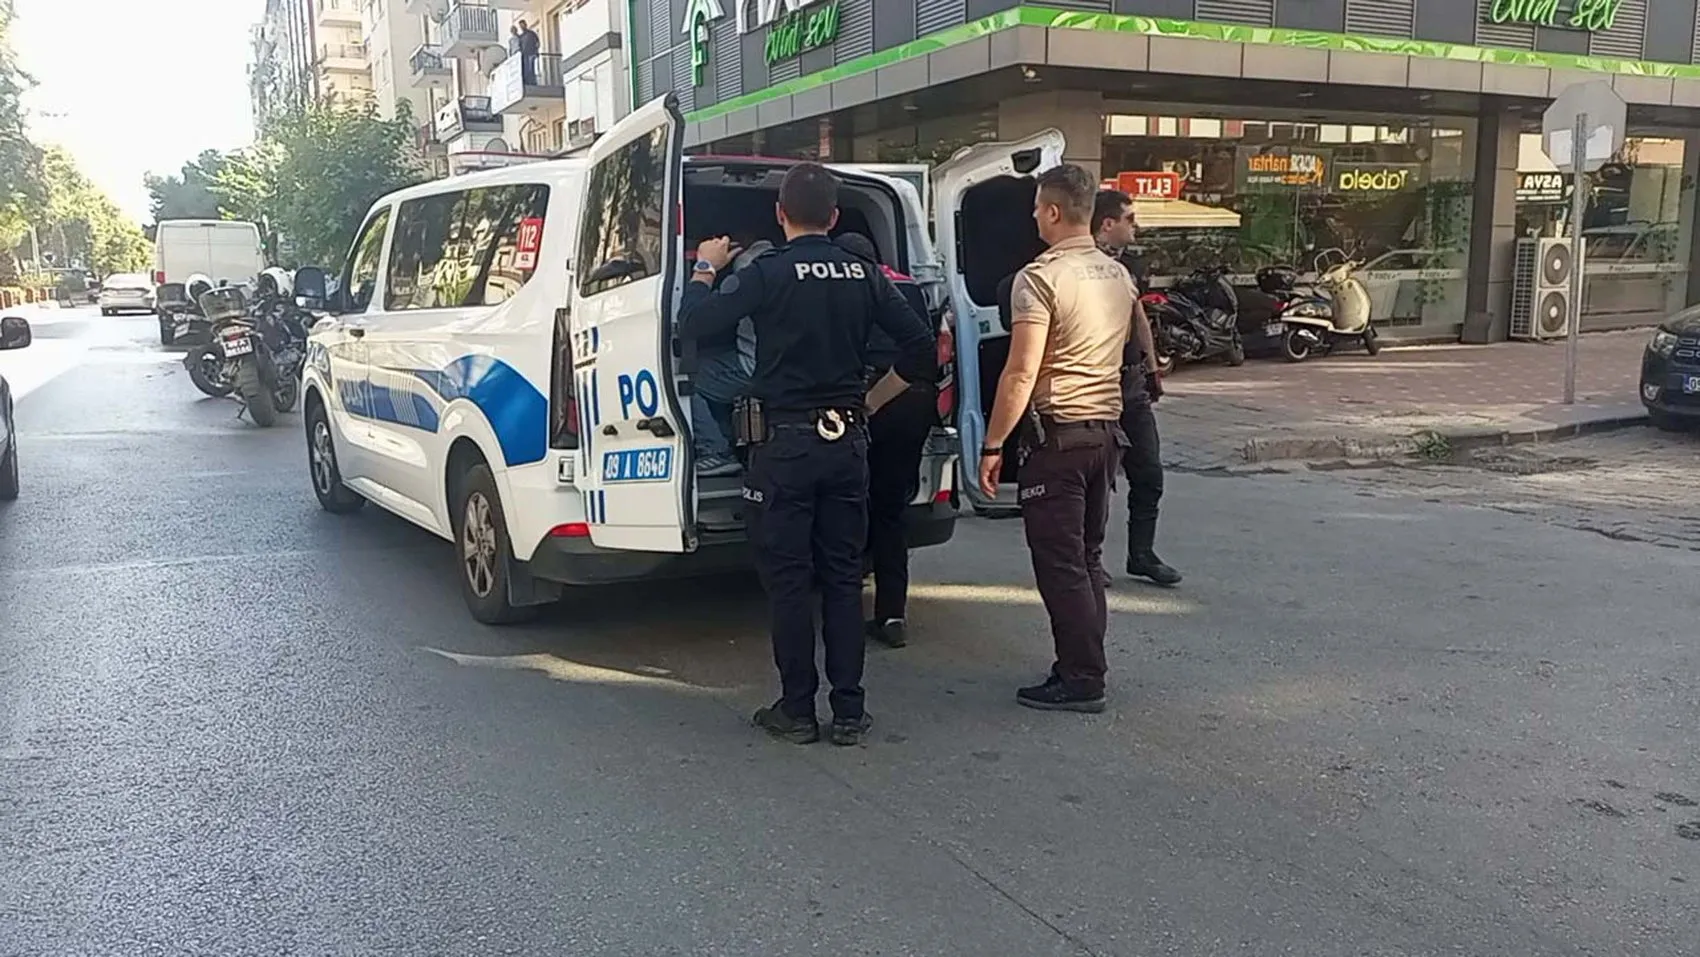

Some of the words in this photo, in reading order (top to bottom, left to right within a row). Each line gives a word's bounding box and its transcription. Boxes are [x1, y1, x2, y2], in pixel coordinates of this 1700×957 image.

[520, 224, 537, 252] 112
[617, 368, 659, 420] PO
[623, 452, 631, 476] A
